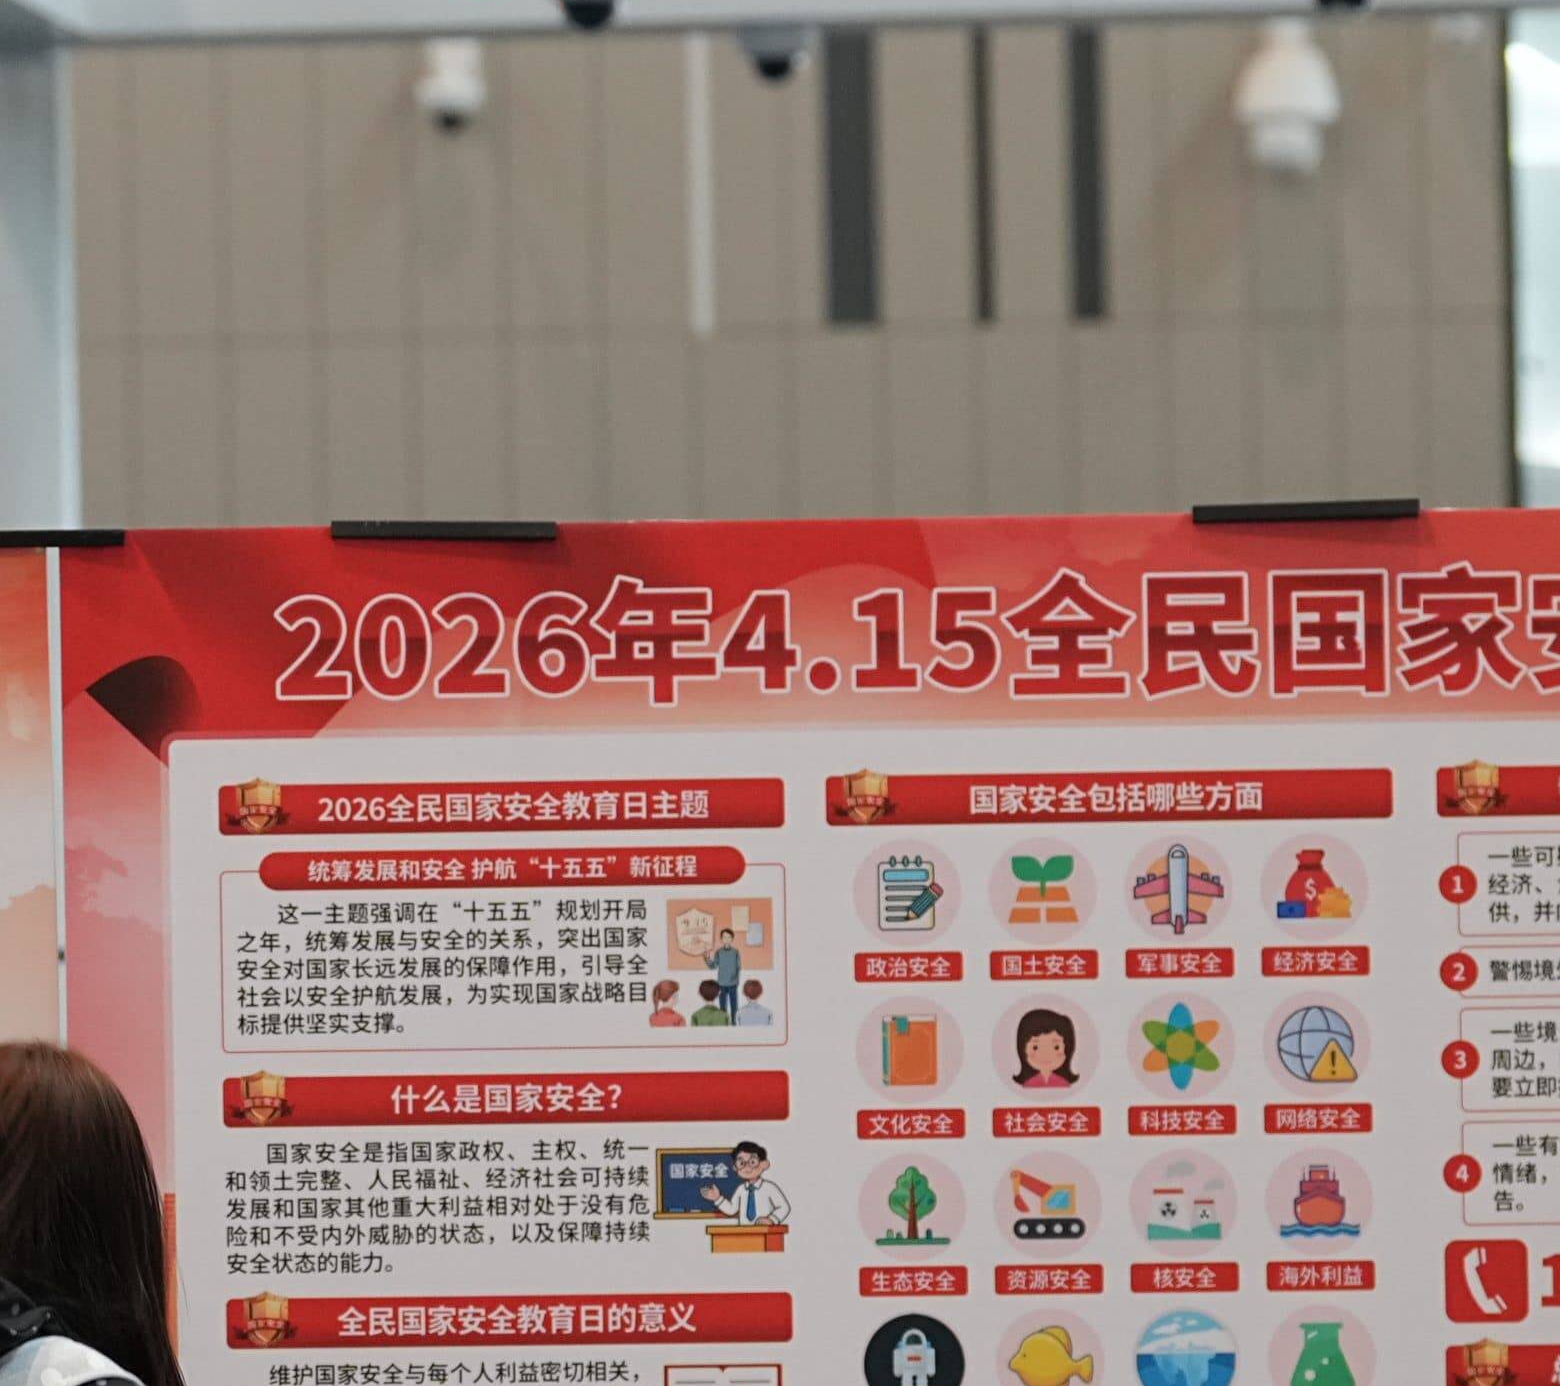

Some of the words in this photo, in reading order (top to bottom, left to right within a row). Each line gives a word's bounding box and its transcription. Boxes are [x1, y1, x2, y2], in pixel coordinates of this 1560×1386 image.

[318, 789, 709, 824] 2026全民国家安全教育日主题
[969, 781, 1263, 815] 国家安全包括哪些方面
[307, 857, 467, 882] 统筹发展和安全
[1451, 875, 1464, 894] 1
[237, 926, 648, 954] 之年，统筹发展与安全的关系，突出国家
[237, 954, 648, 981] 安全对国家长远发展的保障作用，引导全
[866, 956, 951, 979] 政治安全
[1001, 954, 1086, 976] 国土安全
[1137, 953, 1222, 974] 军事安全
[1273, 950, 1358, 973] 经济安全
[1452, 963, 1466, 982] 2
[237, 982, 647, 1008] 社会以安全护航发展，为实现国家战略目
[237, 1012, 408, 1035] 标提供坚实支撑。
[1453, 1050, 1467, 1069] 3
[390, 1082, 623, 1116] 什么是国家安全？
[868, 1114, 953, 1136] 文化安全
[1004, 1112, 1089, 1133] 社会安全
[1140, 1110, 1224, 1132] 科技安全
[1276, 1108, 1360, 1129] 网络安全
[266, 1139, 649, 1165] 国家安全是指国家政权、主权、统一
[225, 1166, 650, 1193] 和领土完整、人民福祉、经济社会可持续
[1455, 1164, 1469, 1182] 4
[225, 1194, 650, 1221] 发展和国家其他重大利益相对处于没有危
[1494, 1191, 1525, 1212] 告。
[226, 1220, 651, 1248] 险和不受内外威胁的状态，以及保障持续
[226, 1251, 394, 1275] 安全状态的能力。
[871, 1270, 956, 1292] 生态安全
[1006, 1269, 1092, 1291] 资源安全
[1153, 1267, 1217, 1289] 核安全
[1279, 1265, 1363, 1287] 海外利益
[337, 1302, 697, 1337] 全民国家安全教育日的意义
[268, 1361, 641, 1386] 维护国家安全与每个人利益密切相关，
